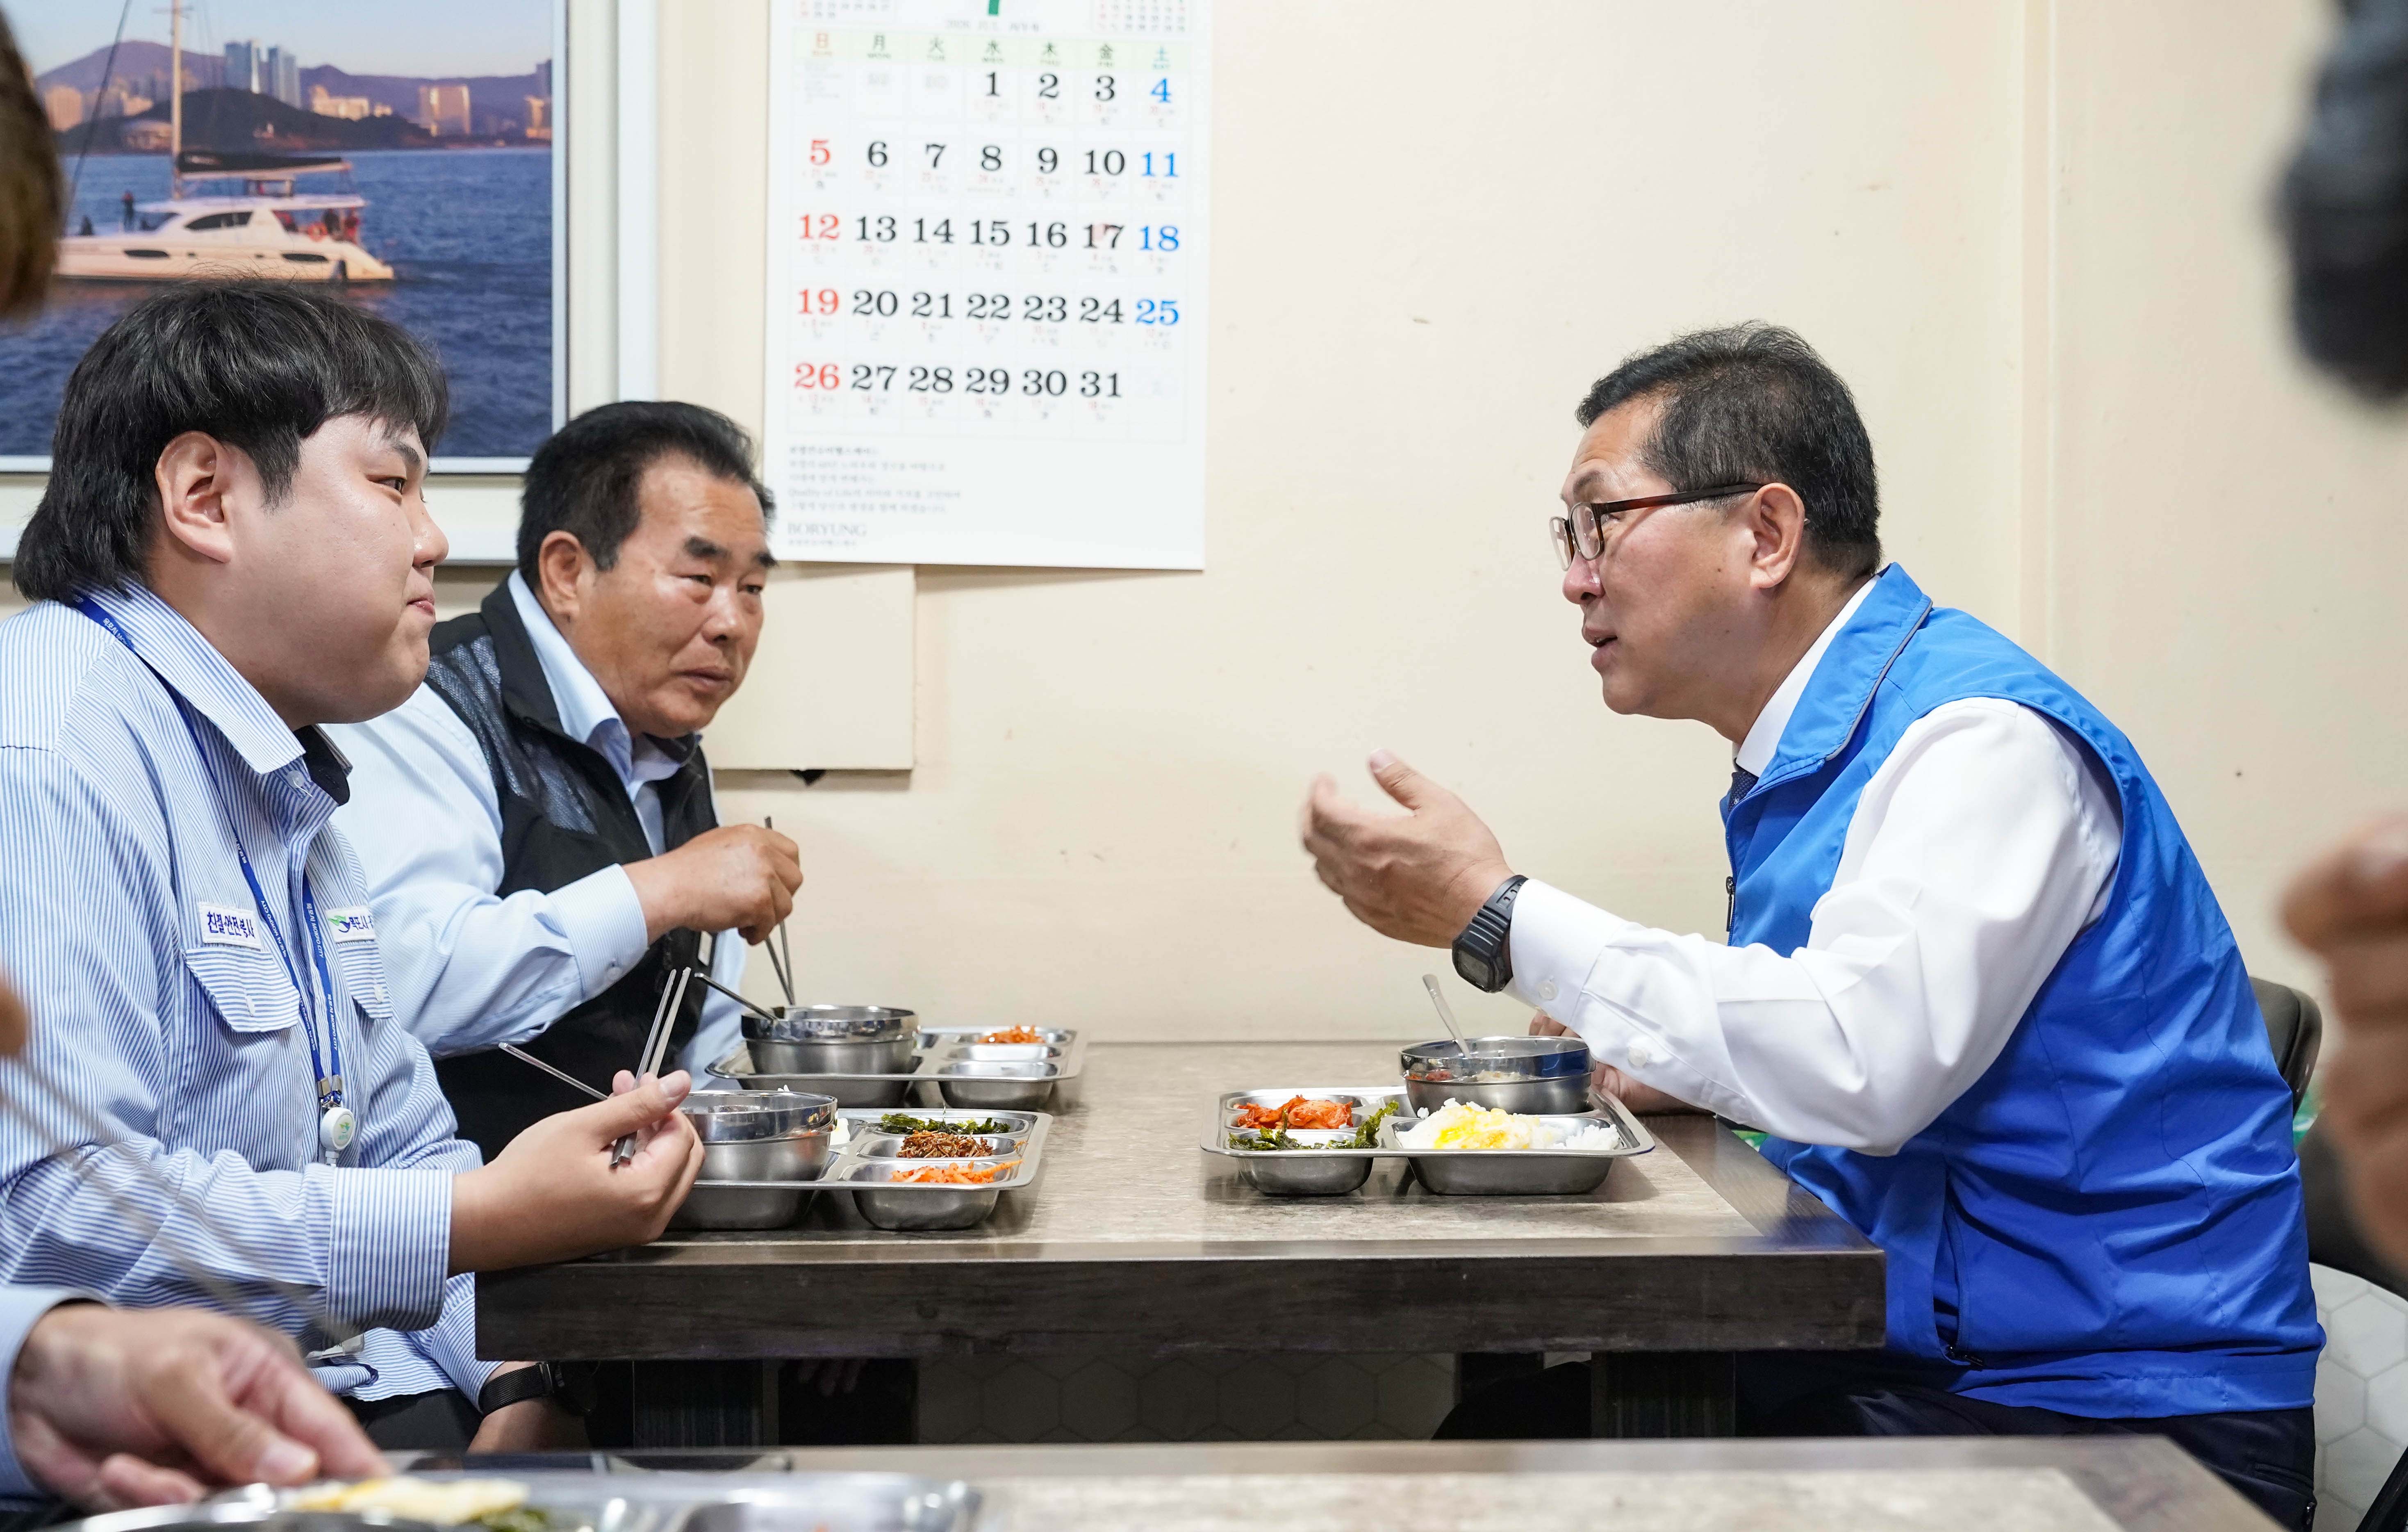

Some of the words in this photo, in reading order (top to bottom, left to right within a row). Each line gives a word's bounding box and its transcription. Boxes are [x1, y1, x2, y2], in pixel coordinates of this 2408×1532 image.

[816, 32, 828, 49] 日
[873, 34, 885, 51] 月
[928, 35, 945, 52] 火
[985, 40, 1001, 55] 水
[1042, 41, 1058, 57] 木
[1099, 43, 1113, 60] 金
[1154, 46, 1170, 62] 土
[987, 72, 1000, 96] 1
[1039, 73, 1058, 99] 2
[1095, 75, 1115, 101] 3
[1151, 78, 1171, 103] 4
[810, 140, 831, 164] 5
[867, 141, 888, 167] 6
[926, 144, 946, 169] 7
[981, 146, 1002, 171] 8
[1038, 148, 1058, 173] 9
[1085, 150, 1125, 176] 10
[1142, 152, 1178, 177] 11
[799, 214, 840, 240] 12
[856, 216, 897, 242] 13
[913, 218, 954, 244] 14
[970, 220, 1010, 246] 15
[1027, 222, 1067, 248] 16
[1083, 224, 1124, 249] 17
[1140, 226, 1179, 251] 18
[799, 289, 839, 314] 19
[853, 290, 898, 317] 20
[912, 292, 953, 318] 21
[967, 294, 1010, 320] 22
[1024, 296, 1067, 322] 23
[1080, 297, 1124, 324] 24
[1136, 299, 1179, 326] 25
[795, 363, 840, 390] 26
[851, 365, 897, 391] 27
[909, 367, 953, 393] 28
[965, 368, 1010, 394] 29
[1022, 370, 1067, 396] 30
[1080, 372, 1122, 397] 31
[261, 900, 269, 914] CITY
[267, 914, 279, 936] MOKPO
[312, 923, 321, 945] MOKPO
